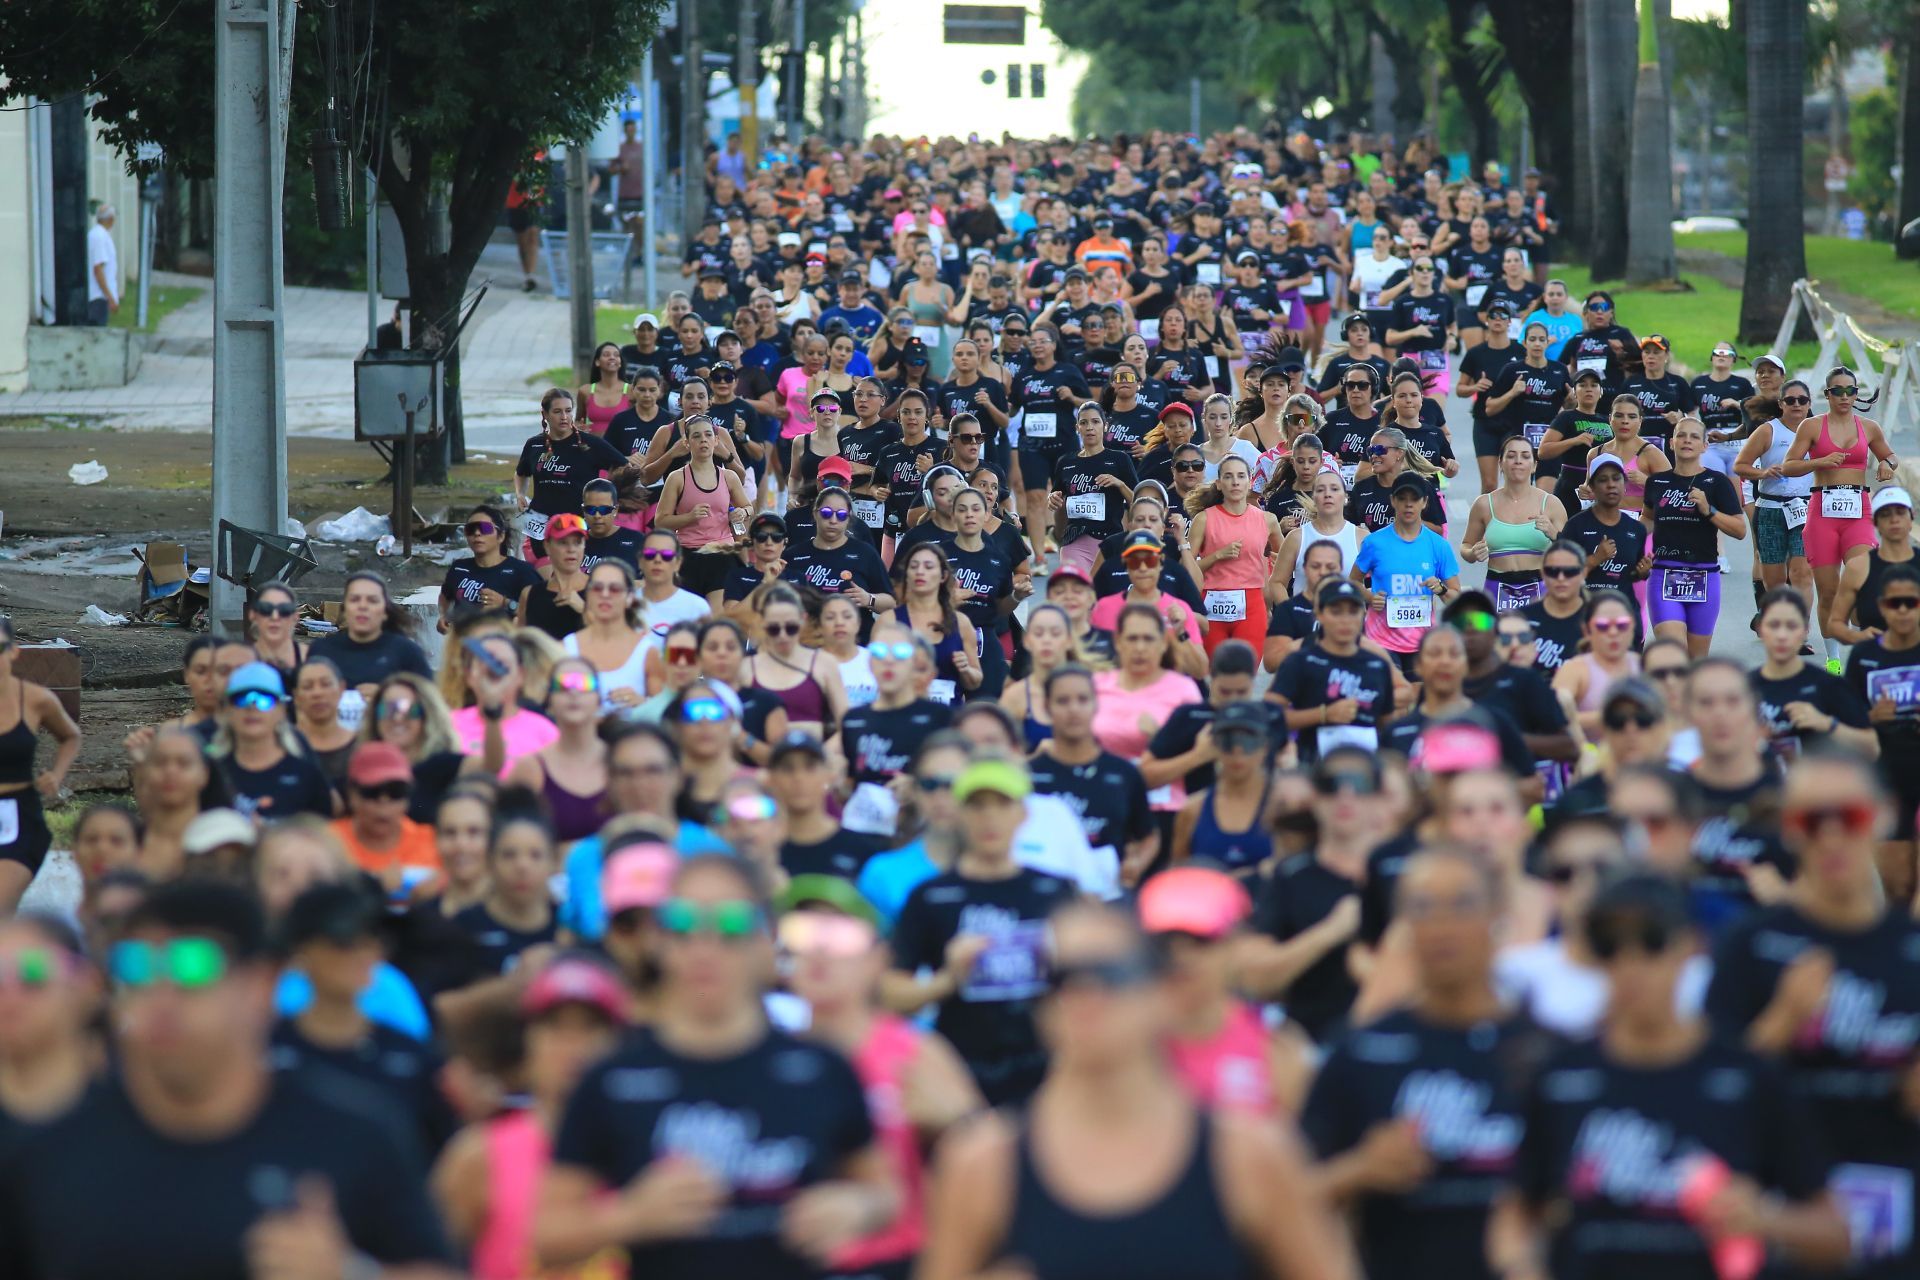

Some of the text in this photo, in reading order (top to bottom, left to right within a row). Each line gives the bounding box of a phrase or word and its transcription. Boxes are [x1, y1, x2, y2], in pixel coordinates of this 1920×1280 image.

[1075, 504, 1097, 514] 5503
[1832, 501, 1854, 512] 6277
[856, 511, 877, 522] 5895
[528, 521, 545, 534] 5727
[1676, 584, 1694, 596] 1117
[1212, 604, 1237, 615] 6022
[1397, 609, 1422, 621] 5984
